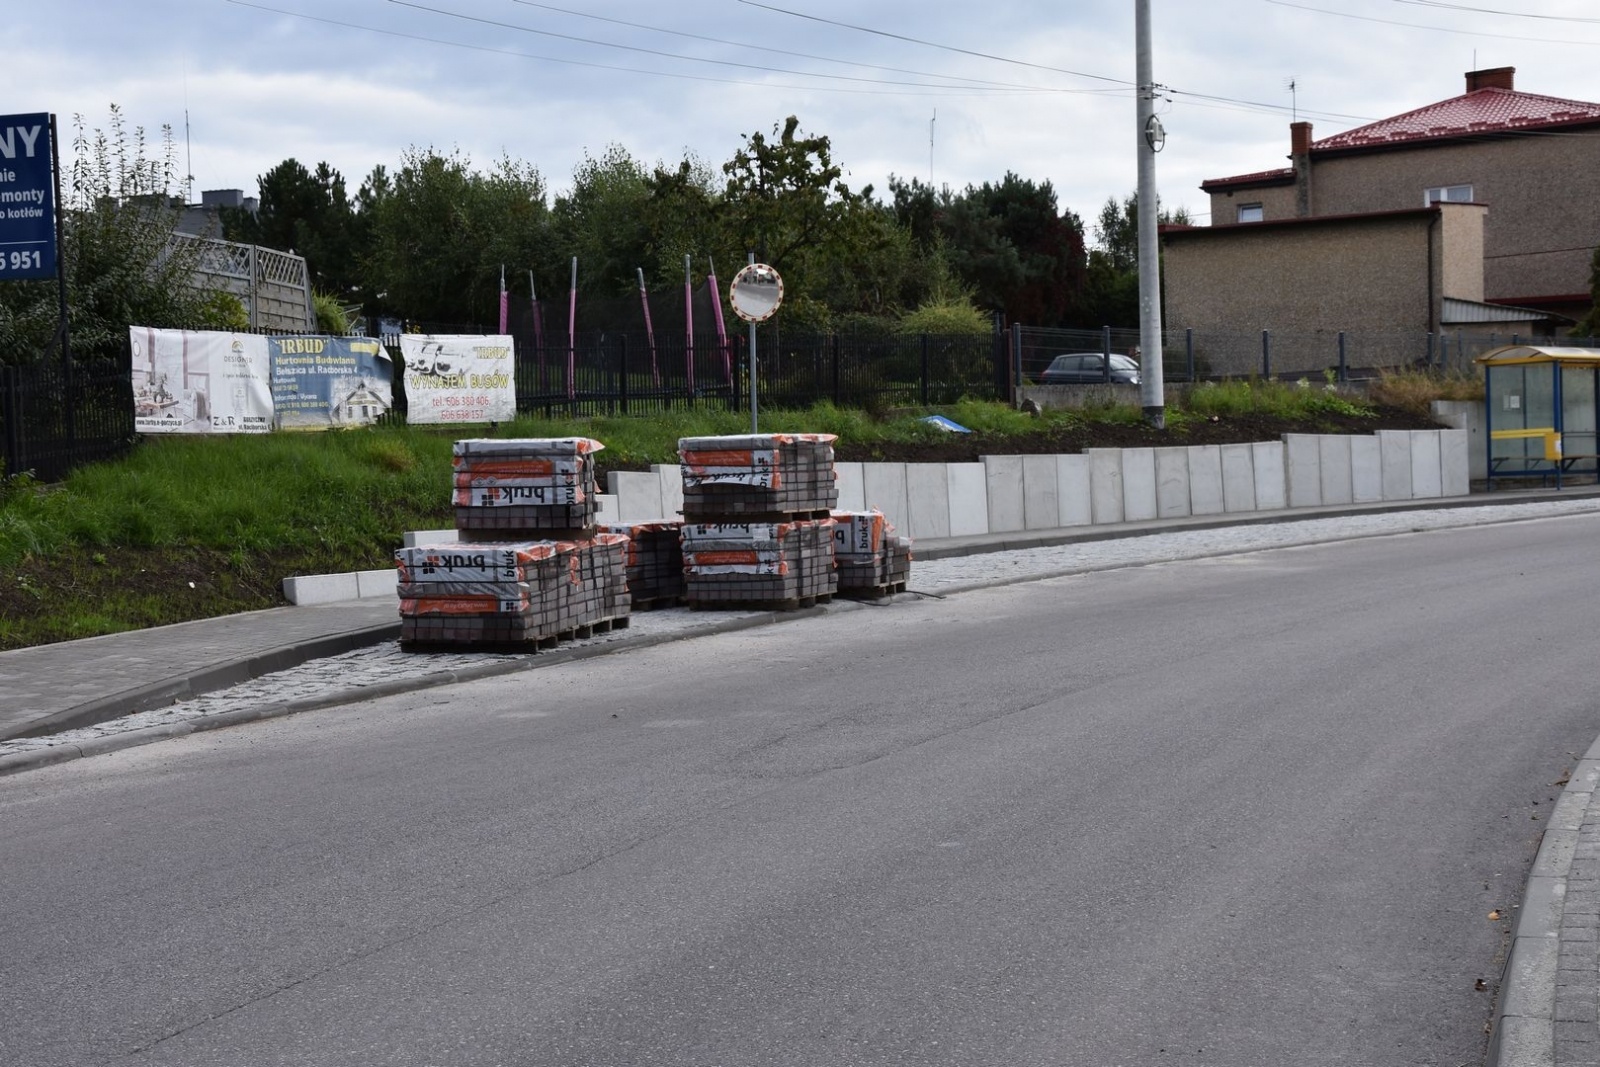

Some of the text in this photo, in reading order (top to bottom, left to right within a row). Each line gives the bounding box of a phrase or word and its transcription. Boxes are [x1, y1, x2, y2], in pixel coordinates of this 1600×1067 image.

[7, 206, 44, 219] kotłów
[10, 250, 41, 270] 951
[308, 366, 316, 374] ul.
[409, 369, 510, 389] WYNAJEM BUSÓW
[432, 397, 445, 407] tel.
[446, 397, 460, 407] 606
[441, 410, 455, 420] 606
[501, 487, 545, 504] bruk
[859, 526, 868, 549] bruk
[441, 555, 485, 573] bruk
[503, 550, 515, 578] bruk
